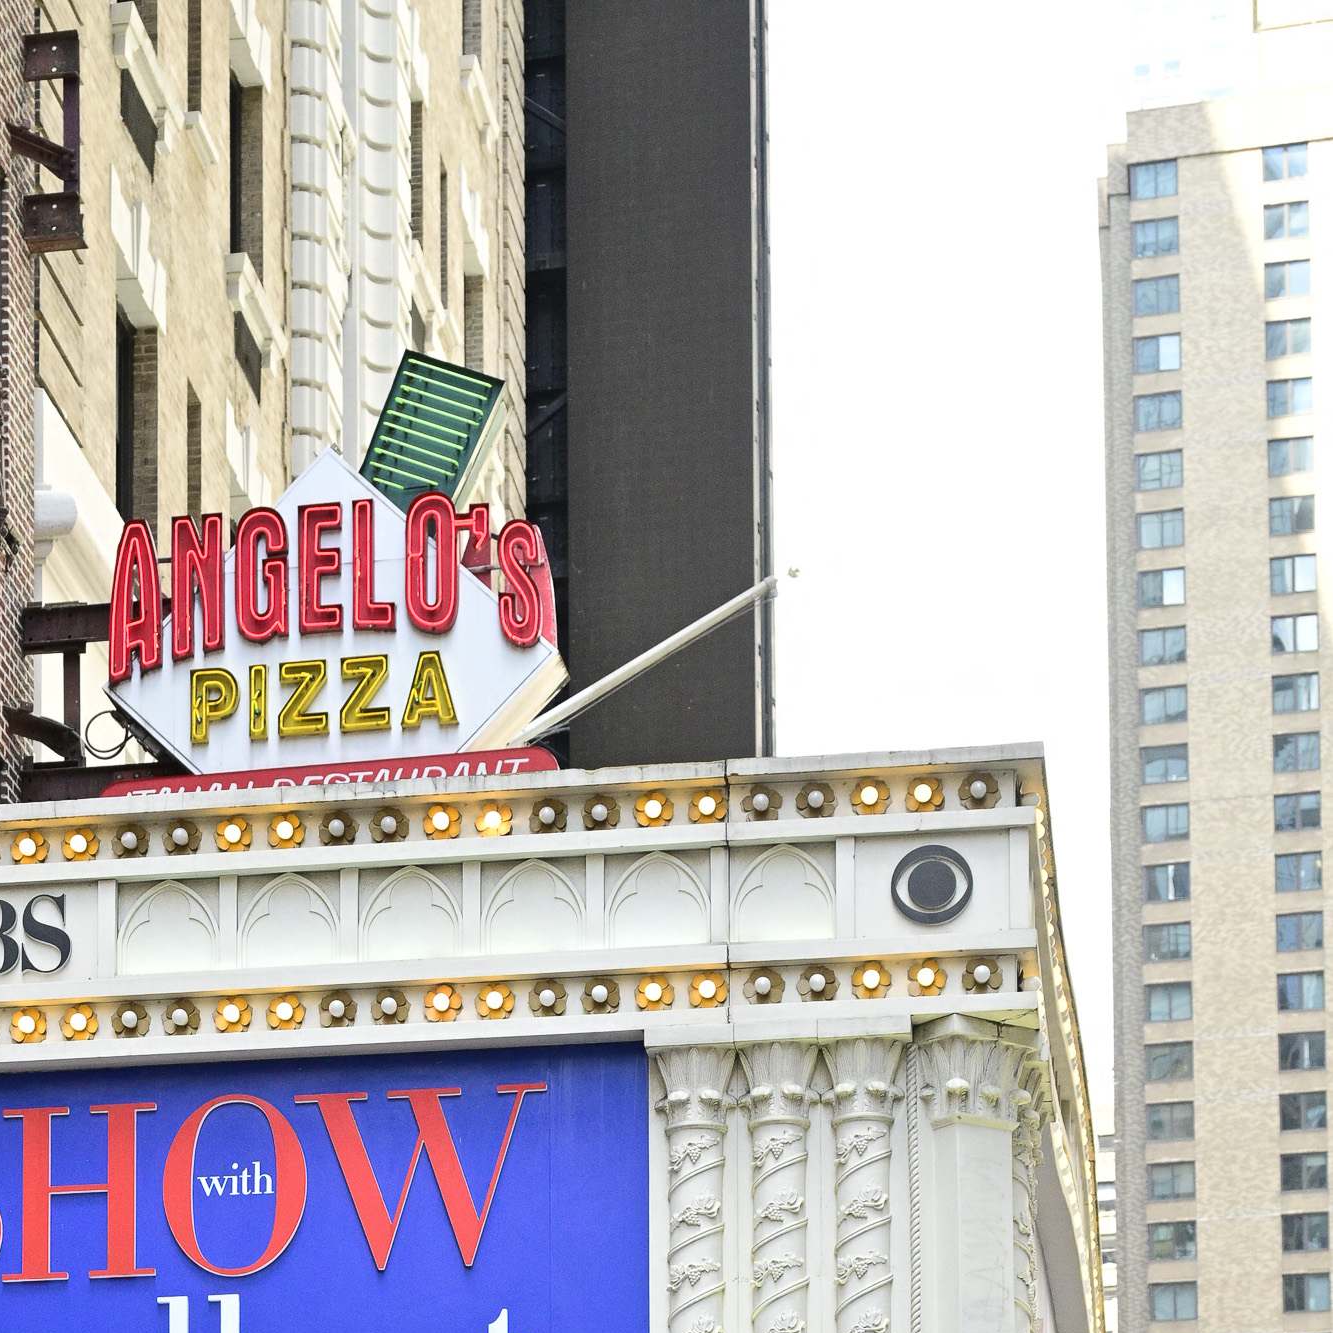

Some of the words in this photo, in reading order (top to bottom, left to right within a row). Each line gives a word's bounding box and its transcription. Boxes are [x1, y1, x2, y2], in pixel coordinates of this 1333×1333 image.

[109, 492, 543, 686] ANGELO'S
[190, 650, 459, 744] PIZZA
[197, 1163, 274, 1198] with
